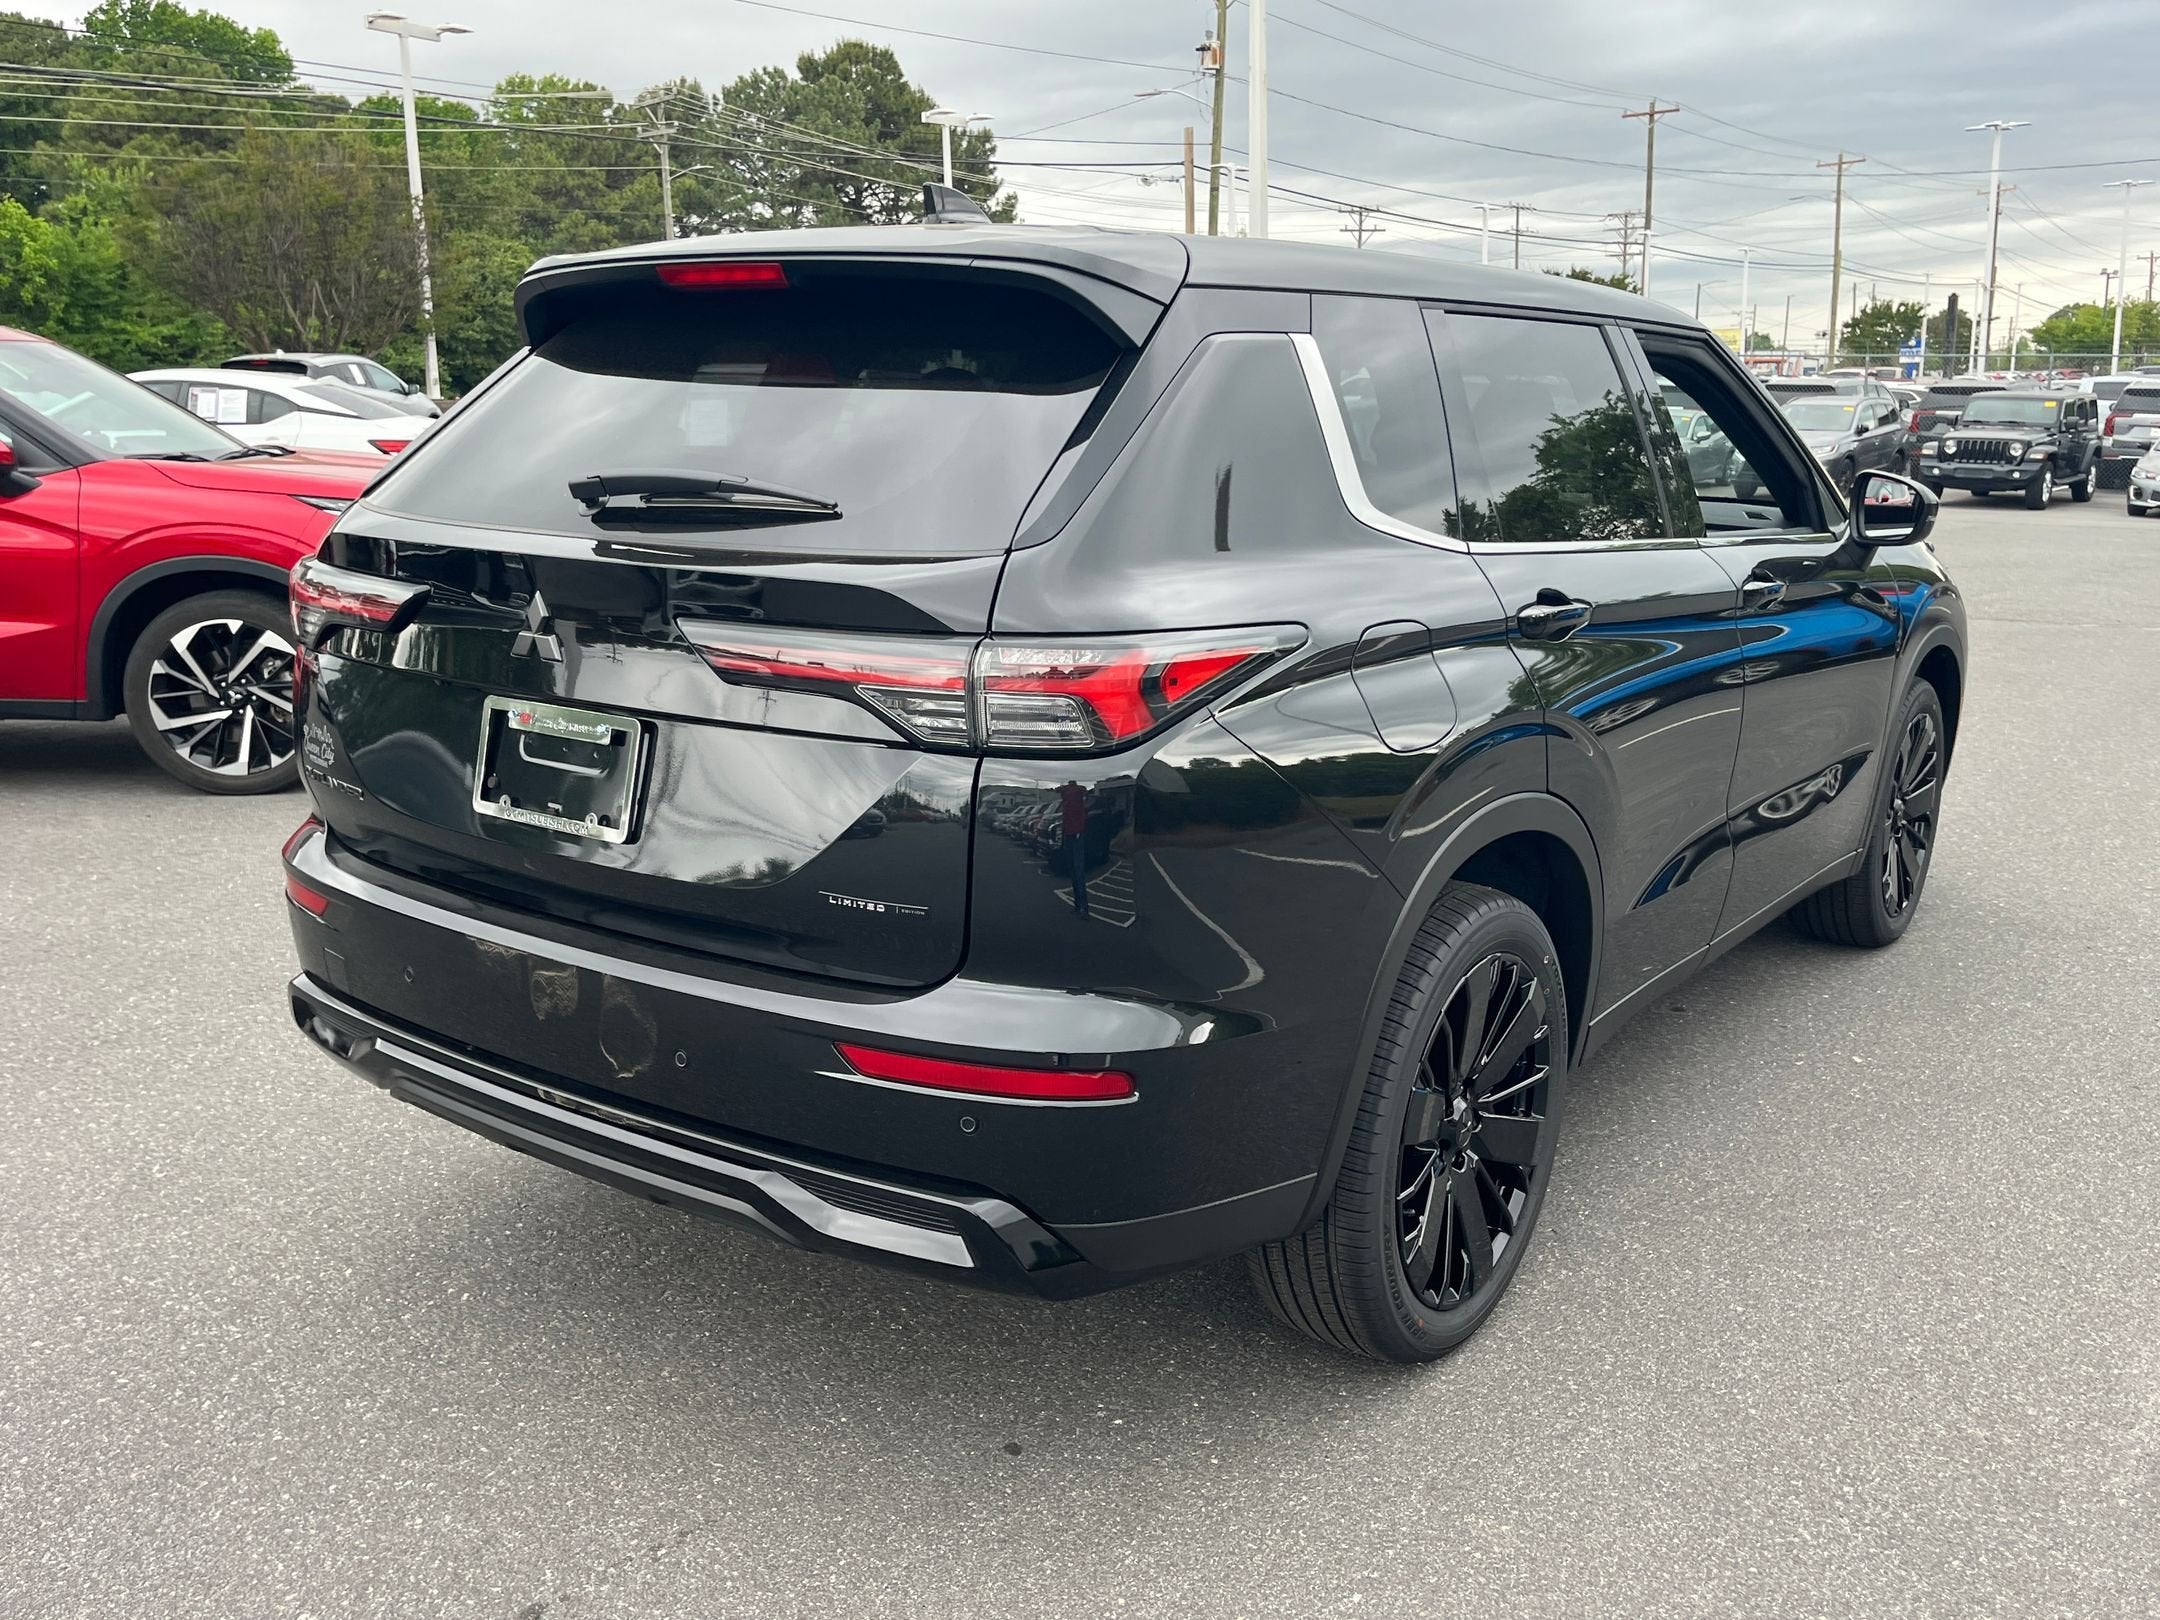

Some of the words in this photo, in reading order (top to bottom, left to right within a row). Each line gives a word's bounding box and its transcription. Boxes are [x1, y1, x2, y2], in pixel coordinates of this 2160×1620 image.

[321, 743, 336, 766] City
[828, 896, 885, 912] LIMITED
[901, 908, 925, 916] EDITION
